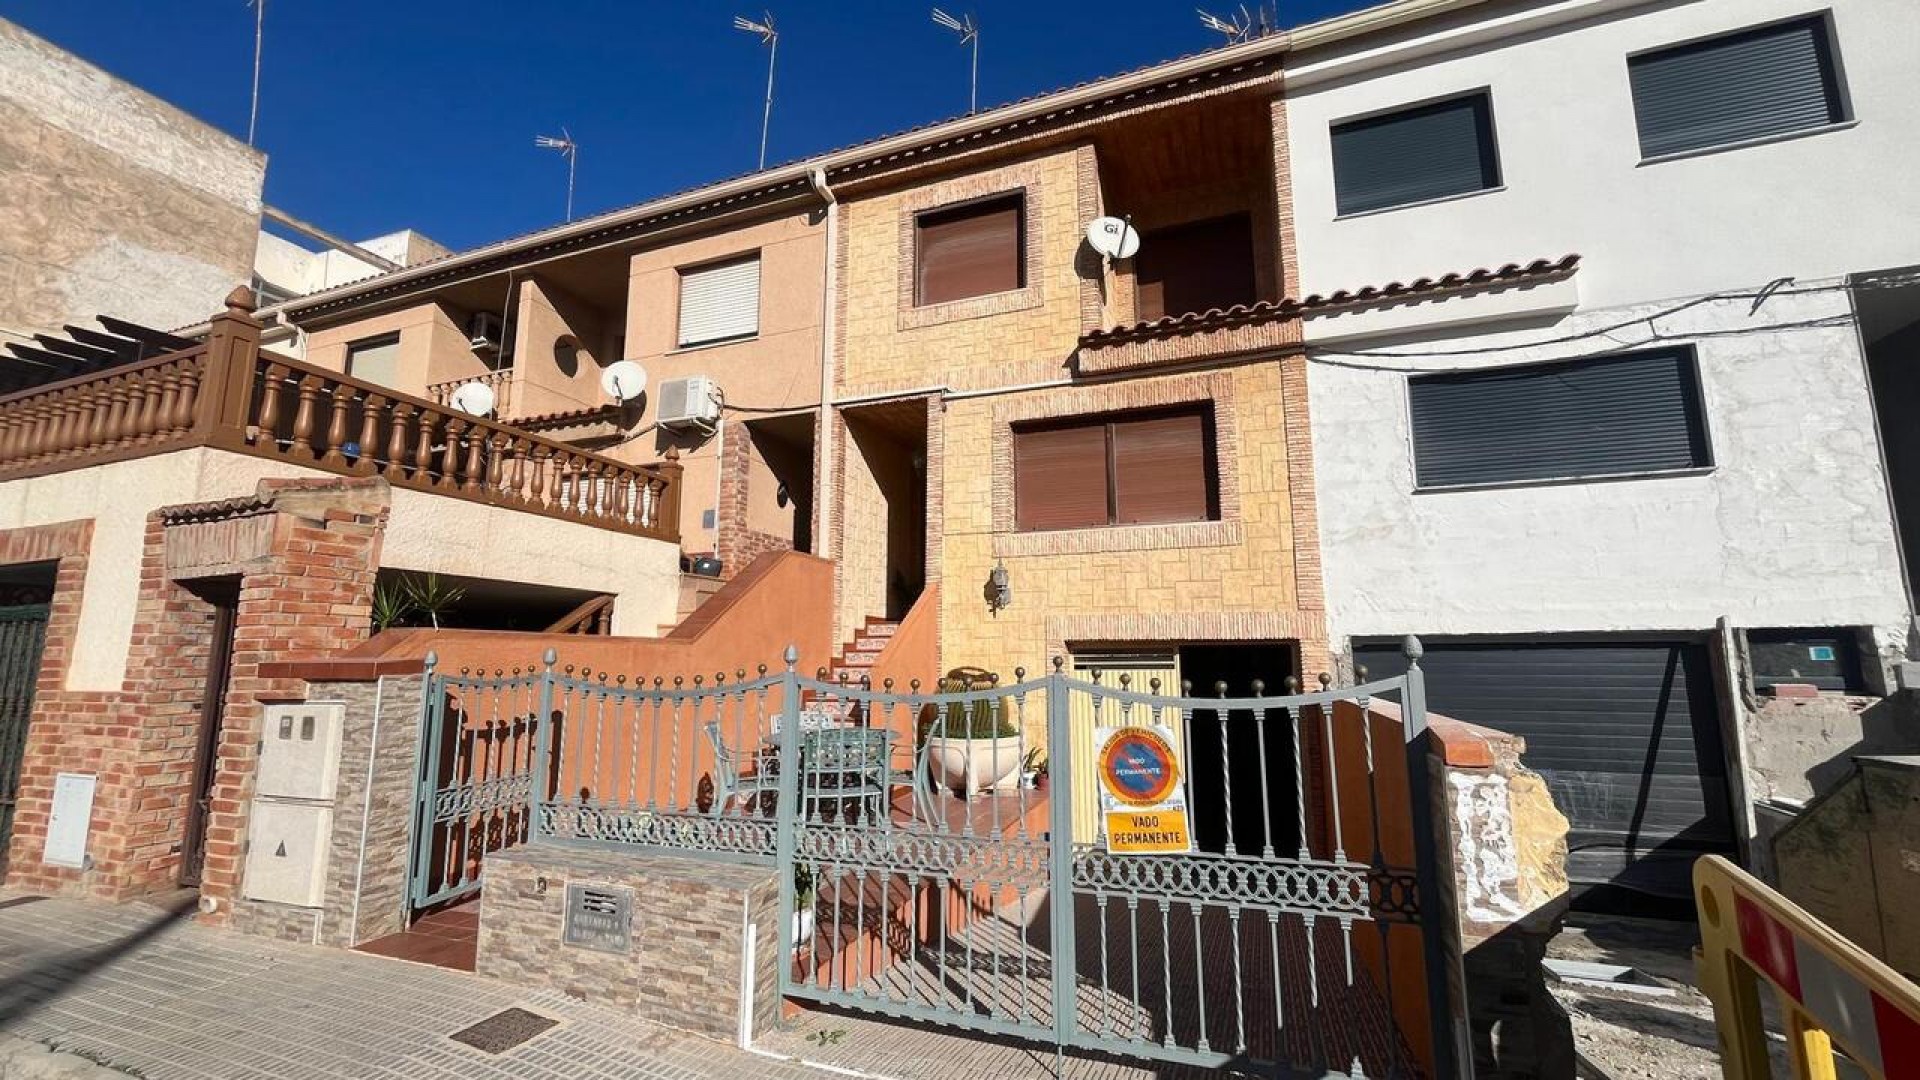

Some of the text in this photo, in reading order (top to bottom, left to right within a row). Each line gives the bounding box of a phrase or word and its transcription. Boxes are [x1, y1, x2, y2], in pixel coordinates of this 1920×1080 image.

[1115, 767, 1161, 775] PERMANENTE
[1132, 816, 1158, 828] VADO
[1114, 832, 1181, 844] PERMANENTE
